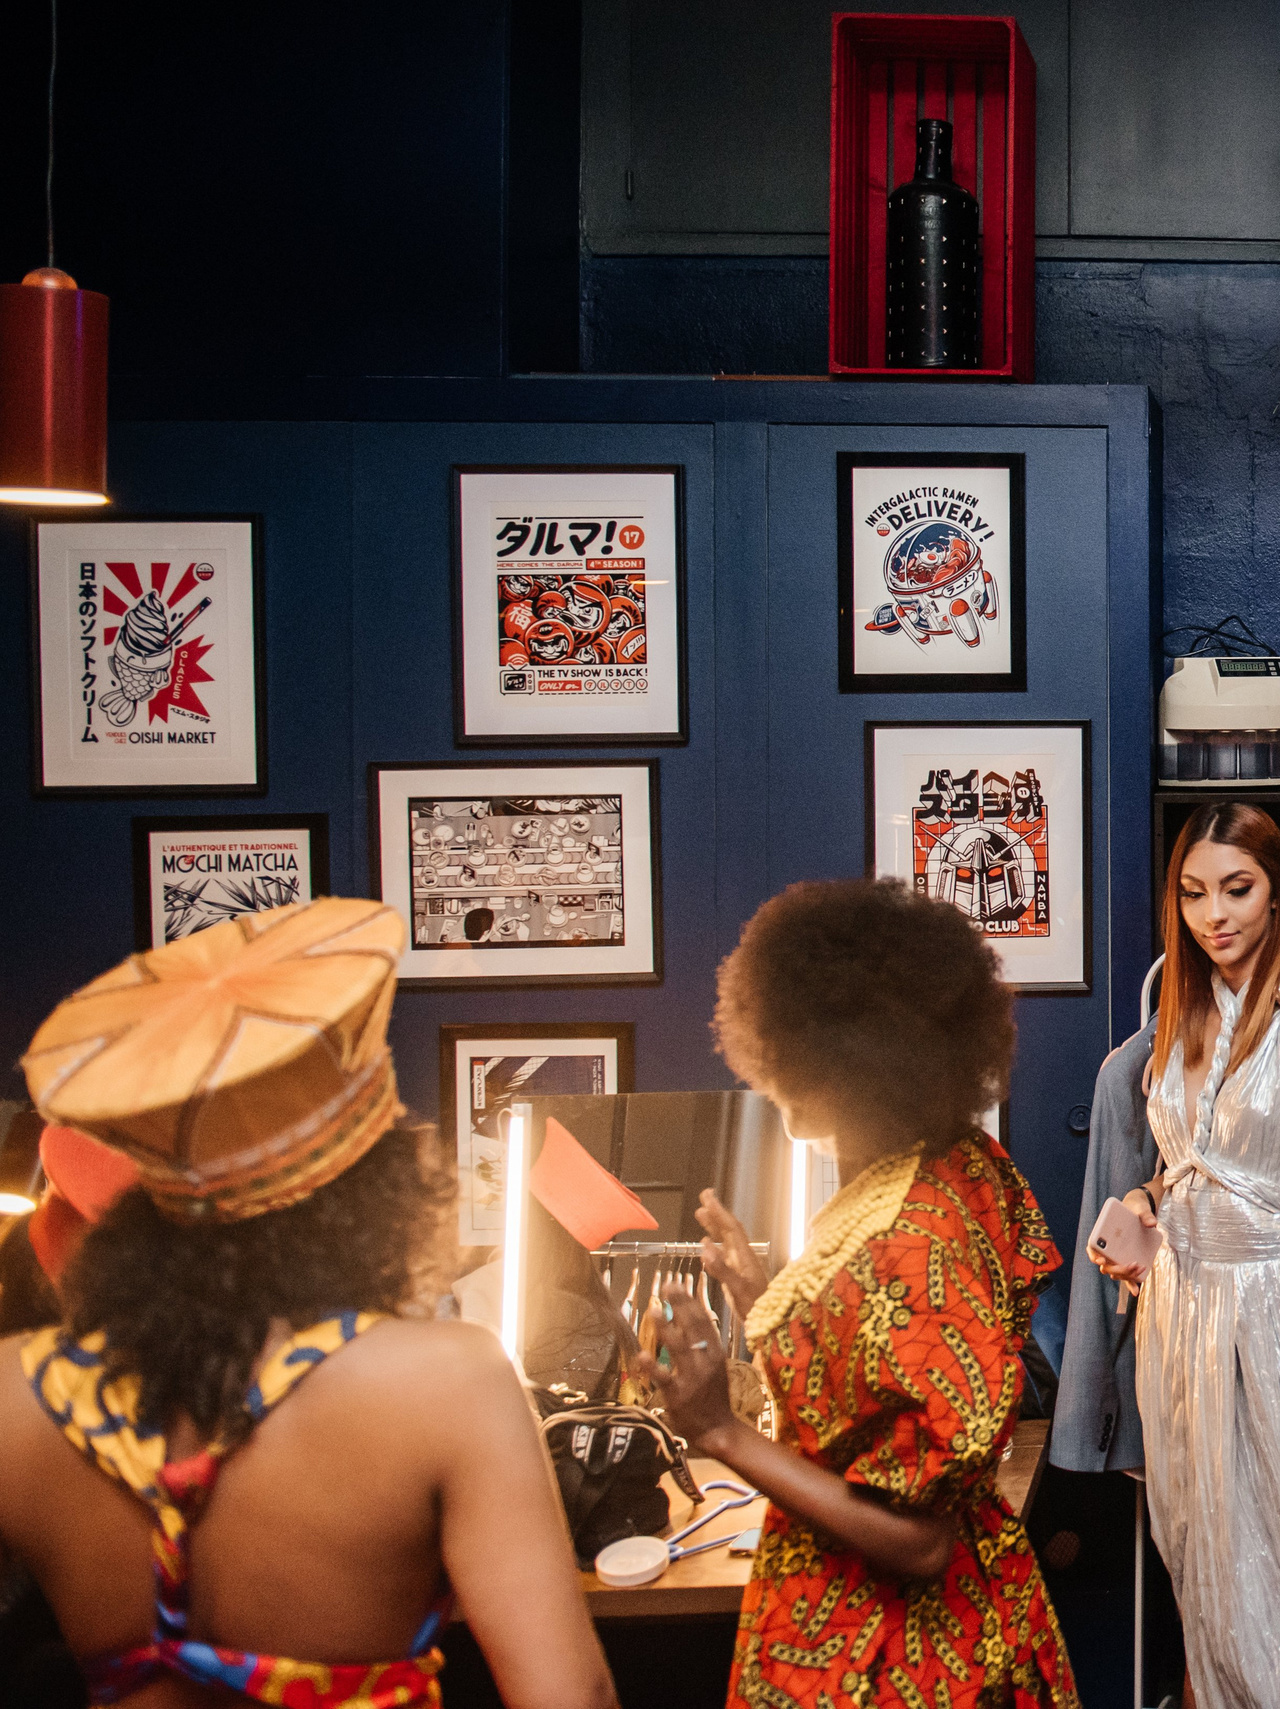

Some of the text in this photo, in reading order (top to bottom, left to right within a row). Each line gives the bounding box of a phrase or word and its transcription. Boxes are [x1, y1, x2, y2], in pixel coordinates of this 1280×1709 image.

[865, 487, 979, 527] INTERGALACTIC RAMEN
[887, 500, 995, 542] DELIVERY!
[623, 531, 640, 544] 17
[79, 563, 99, 743] 日本のソフトクリーム
[172, 650, 188, 699] GLACES
[538, 670, 555, 678] THE
[557, 669, 569, 678] TV
[571, 669, 601, 677] SHOW
[605, 669, 614, 677] IS
[539, 682, 564, 690] ONLY
[129, 731, 216, 744] OISHI MARKET
[162, 844, 227, 852] L'AUTHENTIQUE
[240, 843, 298, 851] TRADITIONNEL
[162, 853, 299, 873] MOCHI MATCHA
[1037, 874, 1047, 919] NAMBA
[985, 920, 1020, 932] CLUB
